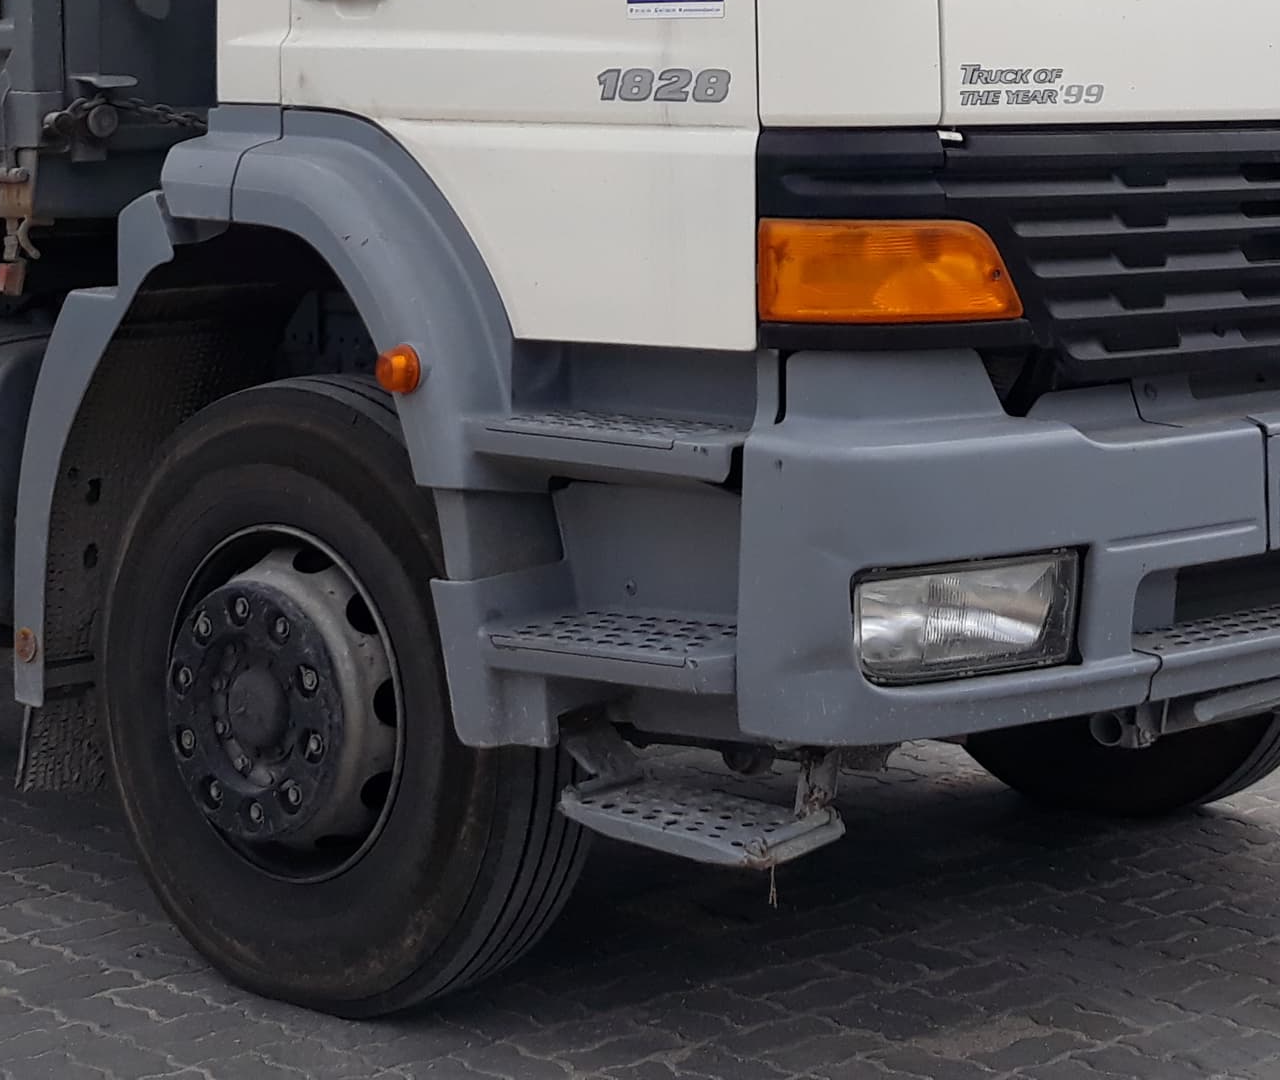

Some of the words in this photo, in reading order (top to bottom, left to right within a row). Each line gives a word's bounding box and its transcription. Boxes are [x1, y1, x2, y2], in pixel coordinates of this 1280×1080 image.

[960, 64, 1032, 84] TRUCK
[1033, 69, 1063, 83] OF
[597, 69, 731, 102] 1828
[960, 90, 1001, 105] THE
[1005, 89, 1058, 104] YEAR
